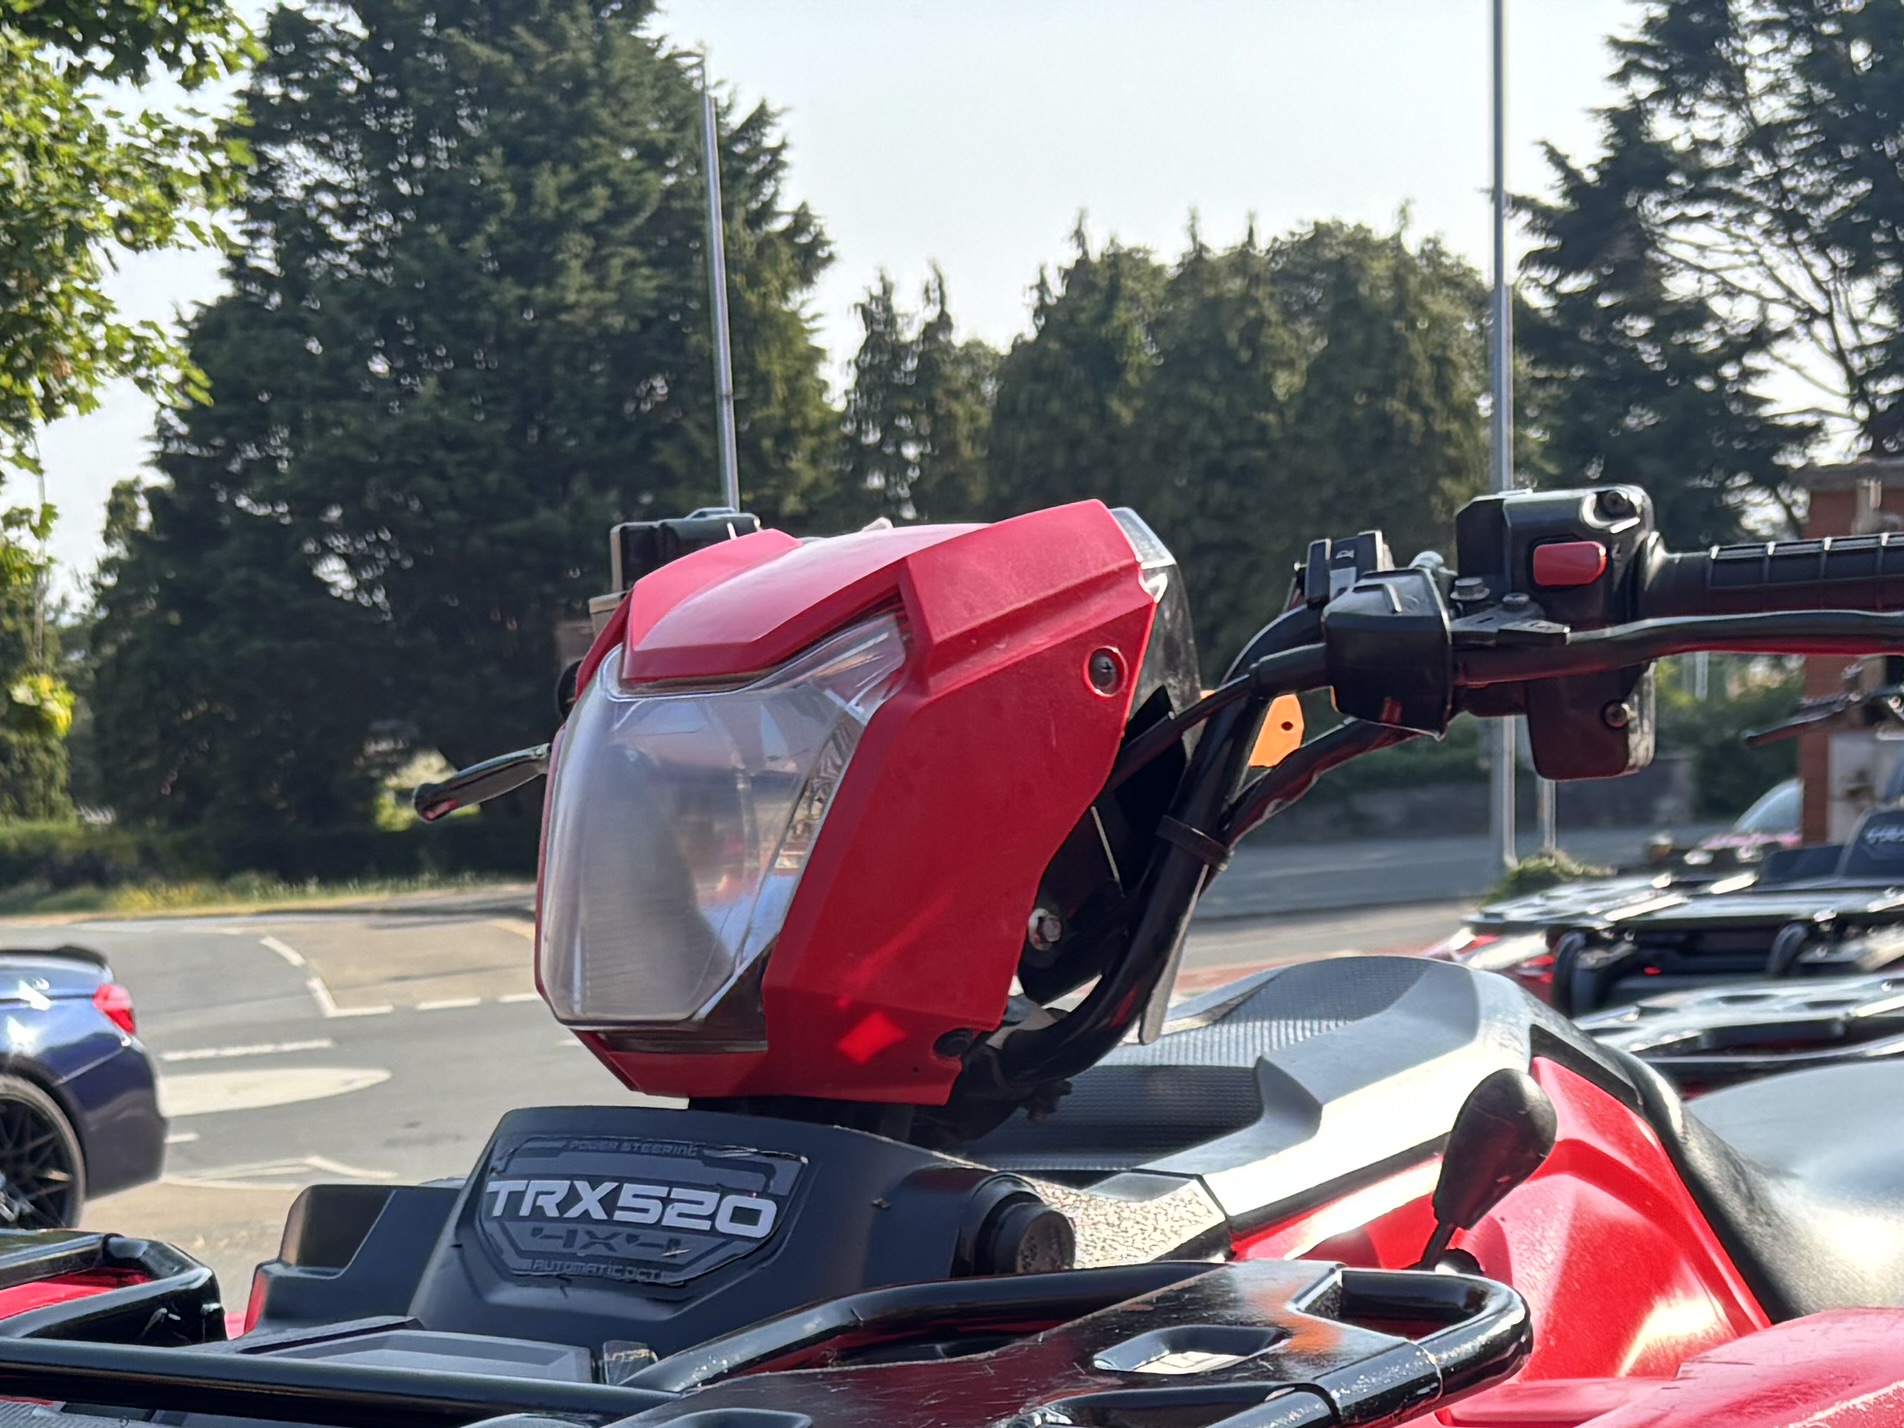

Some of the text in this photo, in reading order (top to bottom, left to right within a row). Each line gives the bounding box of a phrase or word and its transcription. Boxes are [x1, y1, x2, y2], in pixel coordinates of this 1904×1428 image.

[567, 1140, 698, 1156] POWER STEERING
[486, 1179, 778, 1239] TRX520
[529, 1226, 684, 1259] 4X4
[532, 1258, 623, 1278] AUTOMATIC
